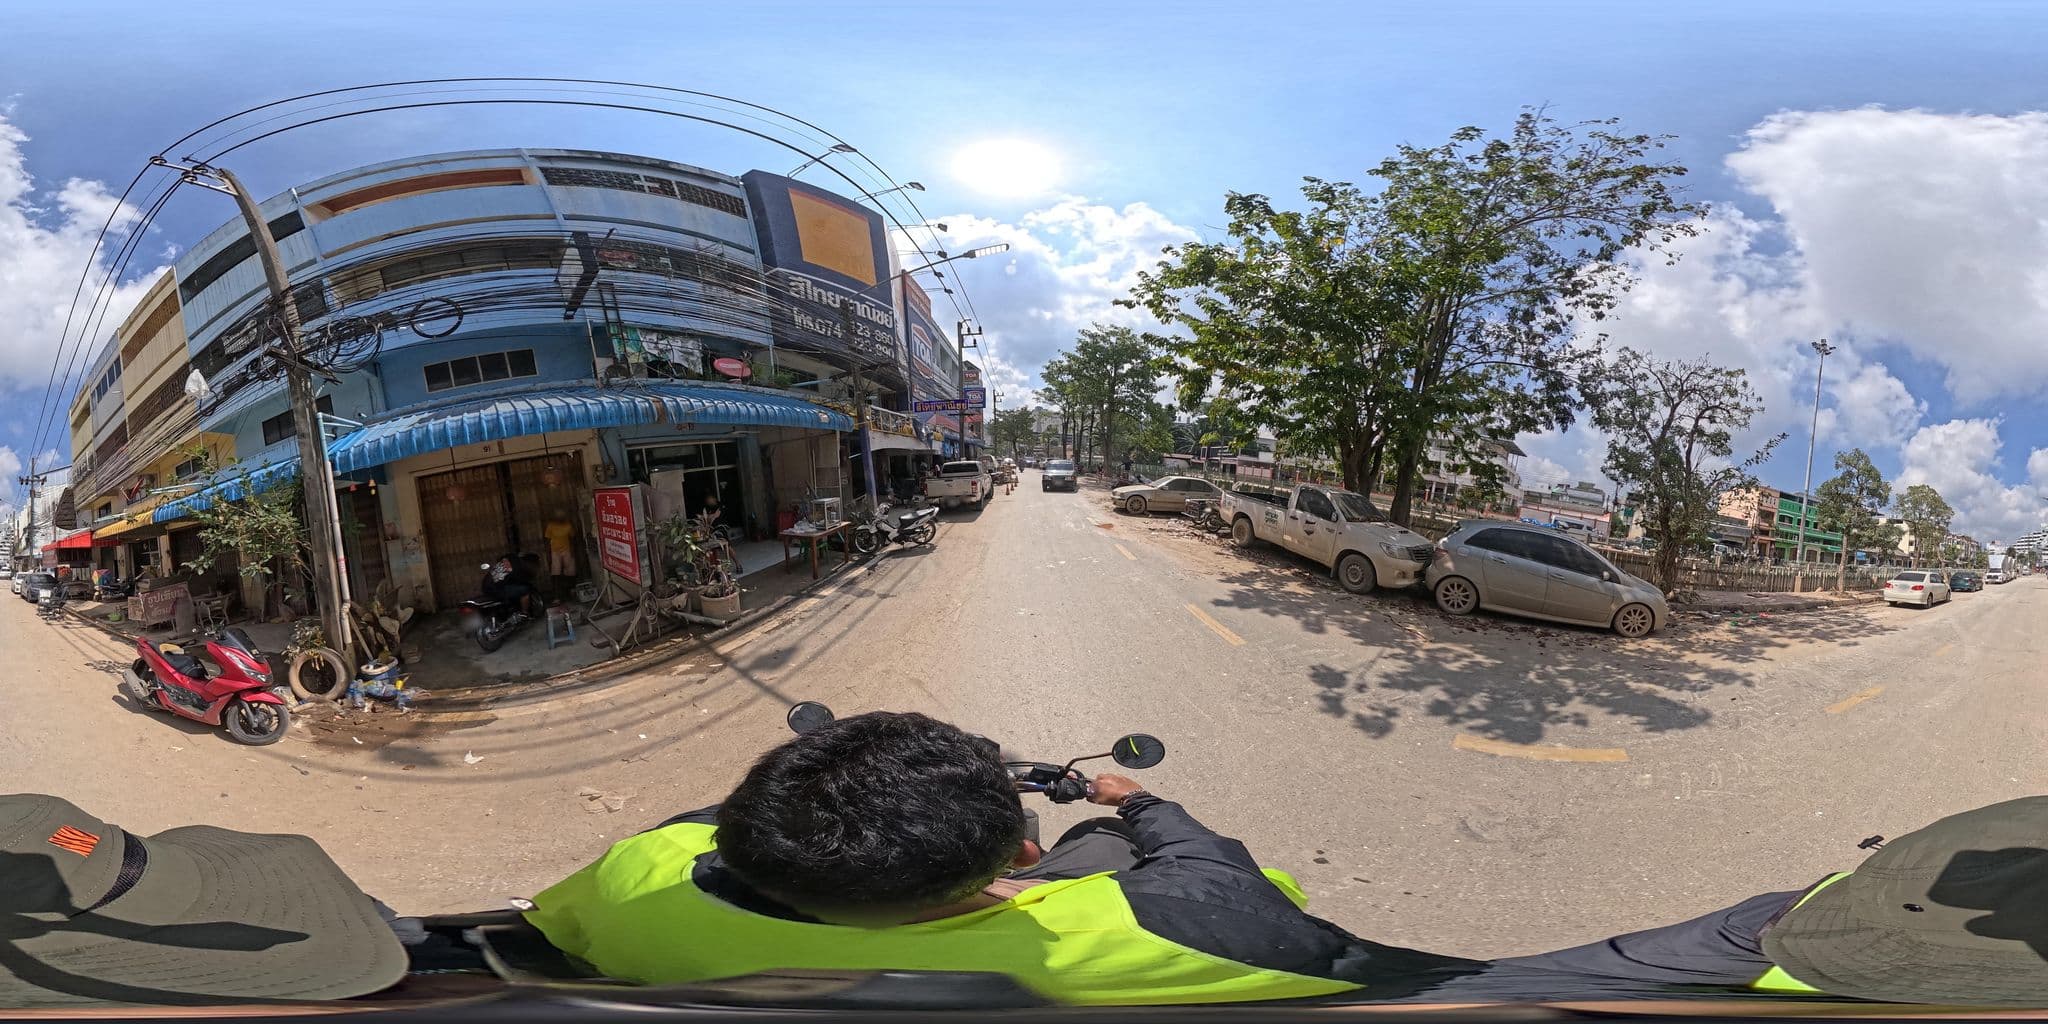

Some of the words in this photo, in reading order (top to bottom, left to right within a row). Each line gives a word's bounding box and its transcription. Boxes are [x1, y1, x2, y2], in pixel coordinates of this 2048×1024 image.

[788, 276, 893, 329] สีไทยาณิชย์
[913, 335, 931, 367] TOA
